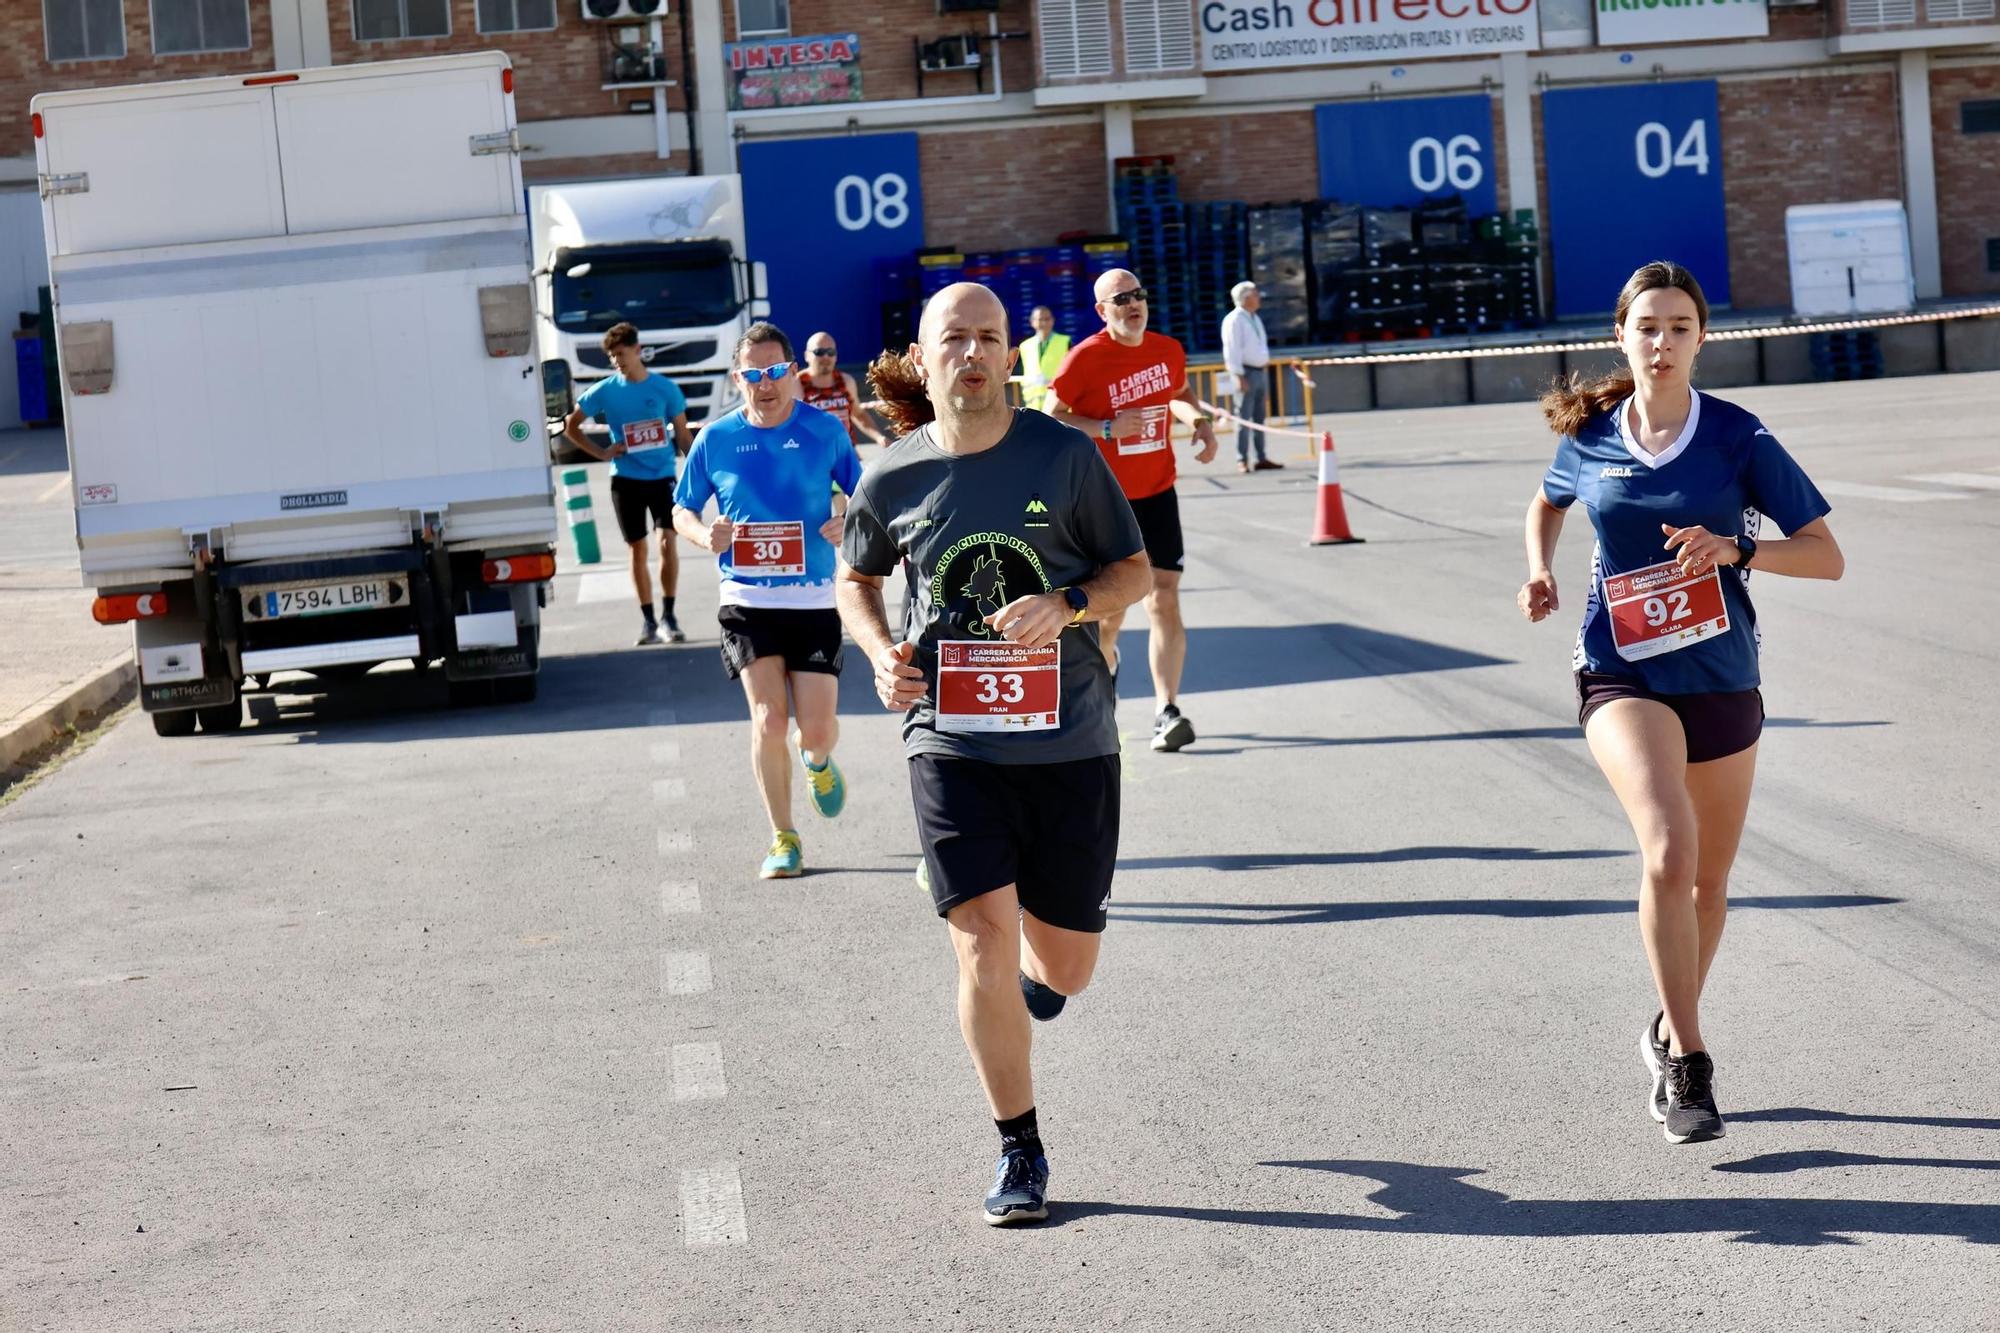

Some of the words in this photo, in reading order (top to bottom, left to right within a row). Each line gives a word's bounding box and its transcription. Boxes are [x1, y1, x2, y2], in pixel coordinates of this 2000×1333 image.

[1203, 0, 1294, 33] Cash
[732, 39, 854, 70] INTESA
[1212, 43, 1256, 60] CENTRO
[1321, 38, 1328, 53] Y
[1410, 29, 1452, 47] FRUTAS
[1454, 28, 1461, 44] Y
[1466, 25, 1525, 44] VERDURAS
[1409, 134, 1483, 192] 06
[1636, 119, 1709, 177] 04
[834, 172, 909, 231] 08
[1111, 375, 1171, 408] SOLIDARIA
[1120, 362, 1169, 392] CARRERA
[282, 493, 346, 508] DHOLLANDIA
[753, 541, 783, 560] 30
[957, 532, 1009, 551] CIUDAD
[1008, 537, 1028, 552] DE
[936, 545, 960, 576] CLUB
[1024, 547, 1054, 594] MURCIA
[932, 574, 946, 608] JUDO
[1635, 569, 1671, 584] CARRERA
[281, 588, 332, 612] 7594
[340, 583, 378, 605] LBH
[1643, 591, 1692, 627] 92
[1660, 623, 1682, 634] CLARA
[969, 655, 1028, 663] MERCAMURCIA
[1012, 647, 1055, 656] SOLIDARIA
[976, 673, 1024, 703] 33
